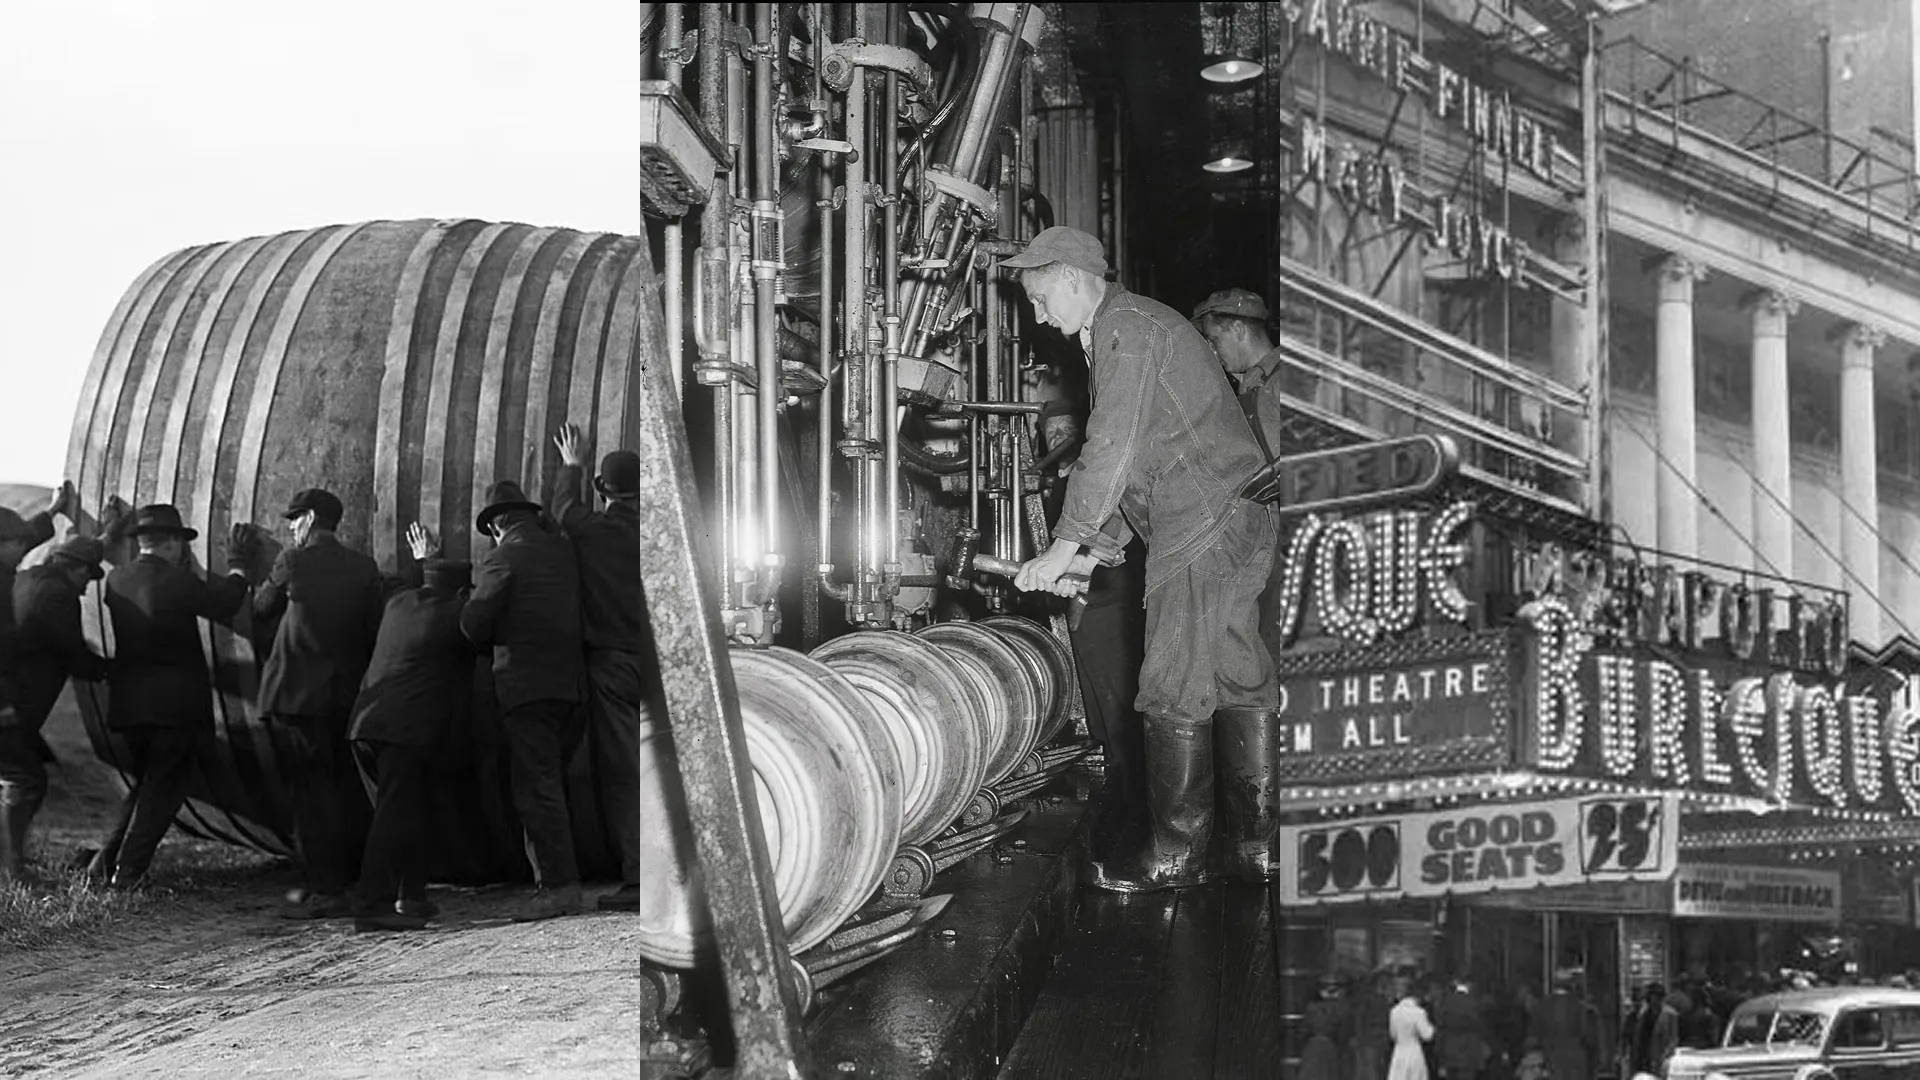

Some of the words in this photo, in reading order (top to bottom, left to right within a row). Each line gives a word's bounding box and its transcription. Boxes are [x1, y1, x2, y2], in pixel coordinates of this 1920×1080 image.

[1320, 663, 1490, 710] THEATRE
[1343, 713, 1411, 750] ALL
[1427, 811, 1557, 852] GOOD
[1300, 825, 1399, 897] 500
[1420, 842, 1565, 886] SEATS
